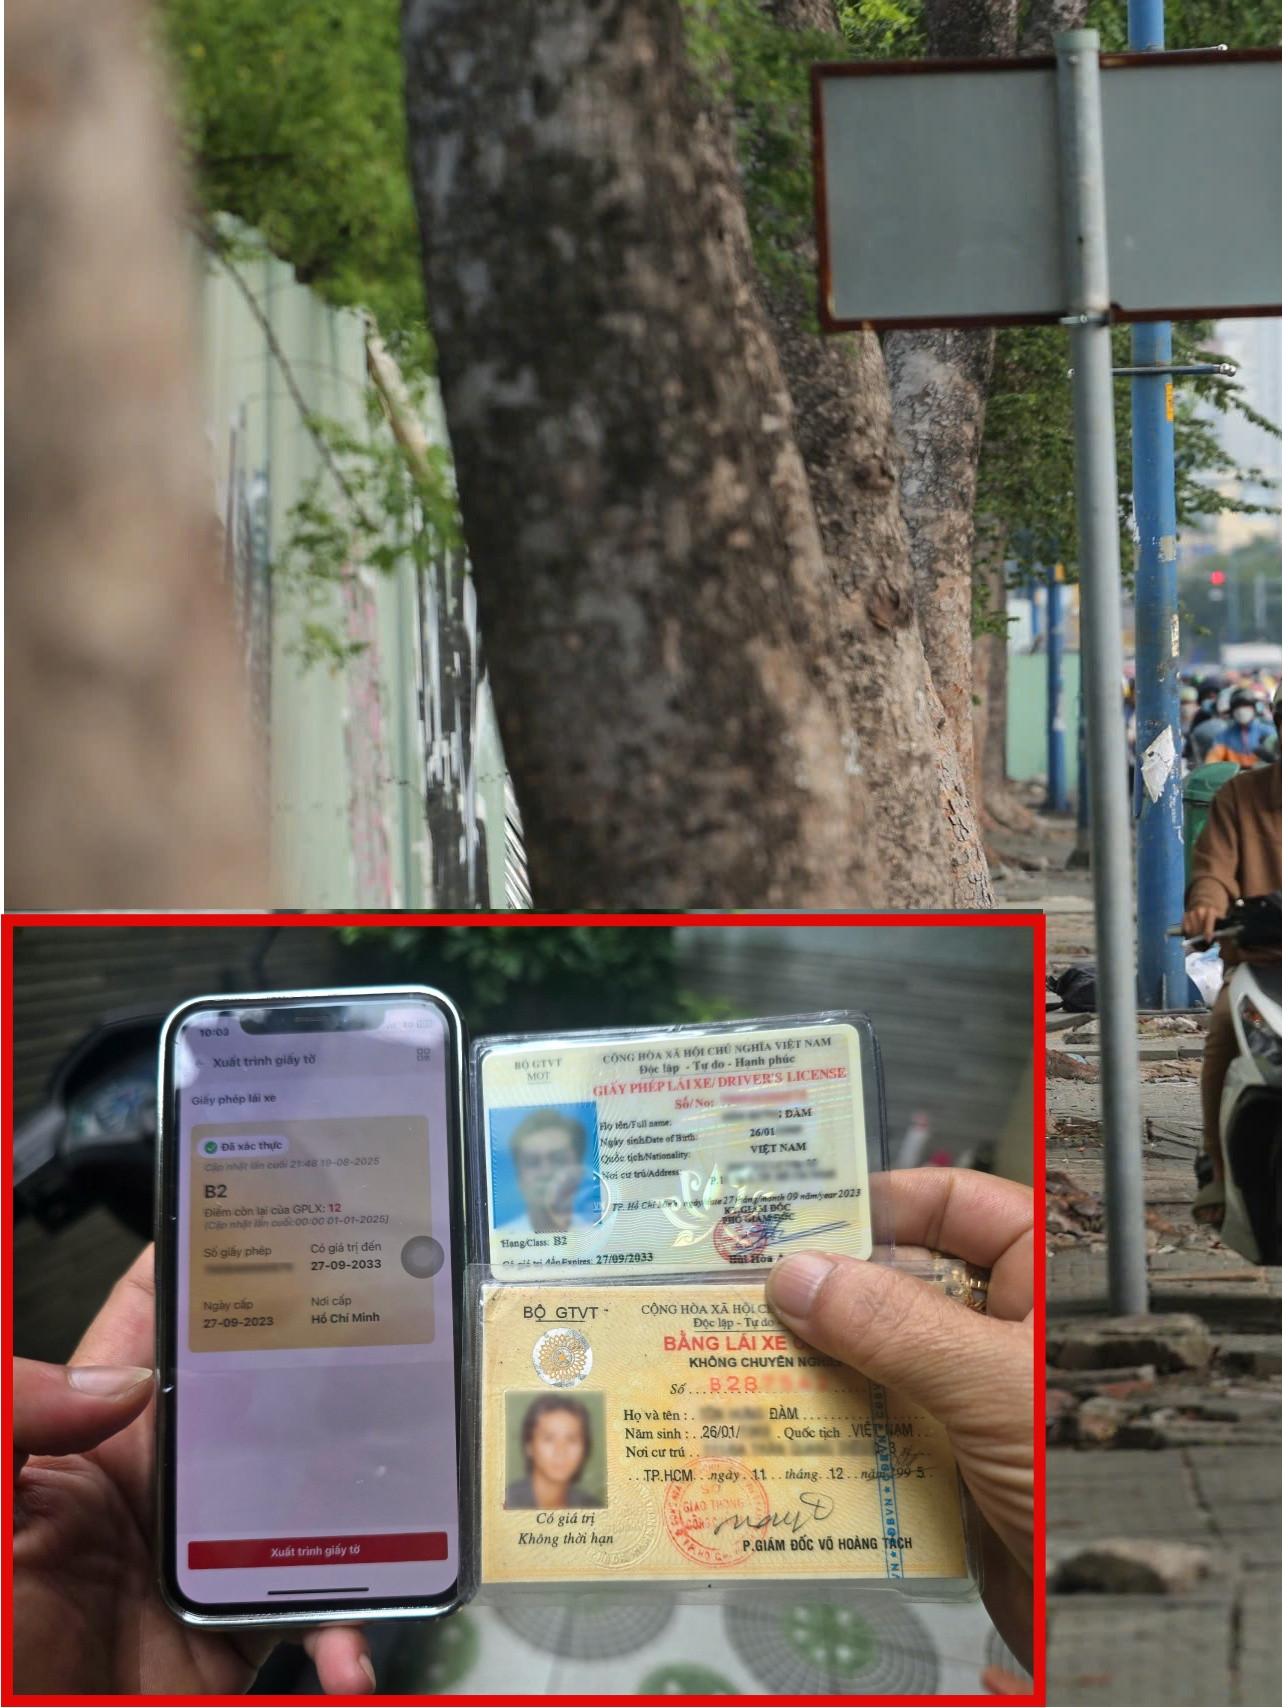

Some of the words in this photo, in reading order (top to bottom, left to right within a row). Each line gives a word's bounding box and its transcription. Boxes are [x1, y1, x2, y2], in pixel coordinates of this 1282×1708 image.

[200, 1028, 230, 1037] 10:03
[603, 1053, 635, 1065] CỘNG
[638, 1050, 663, 1062] HÒA
[684, 1046, 705, 1059] HỘI
[735, 1041, 772, 1054] NGHĨA
[775, 1039, 801, 1052] VIỆT
[804, 1037, 831, 1048] NAM
[213, 1055, 241, 1068] Xuất
[243, 1055, 272, 1067] trình
[275, 1052, 301, 1068] giấy
[303, 1053, 317, 1064] tờ
[532, 1058, 562, 1069] GTVT
[639, 1063, 660, 1076] Độc
[663, 1062, 680, 1075] lập
[692, 1059, 709, 1073] Tự
[712, 1058, 725, 1069] do
[735, 1055, 766, 1069] Hạnh
[768, 1053, 796, 1067] phúc
[527, 1071, 550, 1081] MOT
[593, 1078, 627, 1096] GIẤY
[629, 1077, 664, 1094] PHÉP
[667, 1075, 691, 1091] LÁI
[786, 1067, 847, 1082] LICENSE
[192, 1094, 216, 1107] Giấy
[218, 1094, 246, 1107] phép
[249, 1093, 262, 1103] lái
[264, 1094, 277, 1103] xe
[784, 1107, 812, 1119] ĐÀM
[221, 1142, 235, 1152] Đã
[238, 1141, 256, 1151] xác
[258, 1141, 283, 1152] thực
[600, 1138, 624, 1149] Ngày
[665, 1134, 675, 1143] of
[750, 1143, 777, 1155] VIỆT
[780, 1142, 807, 1153] NAM
[320, 1156, 380, 1168] 19-08-2025
[205, 1184, 228, 1198] B2
[723, 1196, 734, 1205] 27
[786, 1192, 799, 1201] 09
[838, 1188, 862, 1199] 2023
[234, 1204, 254, 1217] còn
[293, 1204, 326, 1215] GPLX:
[328, 1203, 342, 1213] 12
[770, 1202, 791, 1212] ĐỐC
[327, 1214, 389, 1225] 01-01-2025)
[221, 1244, 242, 1259] giấy
[245, 1245, 272, 1259] phép
[311, 1242, 325, 1254] Có
[328, 1242, 344, 1255] giá
[347, 1243, 359, 1255] trị
[361, 1240, 382, 1252] đến
[311, 1259, 382, 1271] 27-09-2033
[596, 1252, 654, 1264] 27/09/2033
[203, 1301, 230, 1313] Ngày
[234, 1297, 254, 1311] cấp
[311, 1296, 329, 1307] Nơi
[332, 1293, 352, 1307] cấp
[523, 1304, 546, 1322] BỘ
[555, 1306, 598, 1319] GTVT
[641, 1302, 678, 1316] CỘNG
[681, 1302, 708, 1314] HÒA
[711, 1302, 729, 1314] XÃ
[732, 1302, 755, 1315] HỘI
[203, 1317, 274, 1329] 27-09-2023
[311, 1311, 327, 1324] Hồ
[330, 1312, 349, 1324] Chí
[352, 1312, 380, 1323] Minh
[693, 1317, 716, 1329] Độc
[719, 1317, 734, 1330] lập
[744, 1317, 759, 1330] Tự
[761, 1318, 774, 1328] do
[664, 1330, 719, 1352] BẰNG
[726, 1332, 755, 1351] LÁI
[761, 1335, 787, 1350] XE
[689, 1354, 737, 1368] KHÔNG
[740, 1354, 794, 1368] CHUYÊN
[670, 1381, 686, 1396] Số
[623, 1409, 642, 1424] Họ
[645, 1410, 660, 1420] và
[663, 1409, 681, 1420] tên
[769, 1406, 799, 1420] ĐÀM
[625, 1426, 651, 1440] Năm
[654, 1426, 682, 1439] sinh
[784, 1425, 816, 1441] Quốc
[819, 1427, 841, 1441] tịch
[886, 1423, 913, 1437] NAM
[626, 1445, 648, 1458] Nơi
[651, 1448, 668, 1458] cư
[669, 1446, 684, 1458] trú
[644, 1468, 693, 1482] TP.HCM
[711, 1469, 739, 1483] ngày
[752, 1468, 766, 1481] 11
[784, 1468, 818, 1483] tháng
[830, 1467, 843, 1480] 12
[536, 1512, 554, 1524] Có
[558, 1512, 578, 1527] giá
[581, 1512, 595, 1526] trị
[518, 1532, 559, 1547] Không
[563, 1532, 587, 1544] thời
[591, 1532, 614, 1547] hạn
[743, 1536, 786, 1552] P.GIÁM
[790, 1534, 814, 1551] ĐỐC
[818, 1536, 834, 1550] VÕ
[838, 1534, 878, 1550] HOÀNG
[271, 1545, 295, 1557] Xuất
[297, 1545, 323, 1557] trình
[325, 1543, 347, 1557] giấy
[349, 1544, 360, 1554] tờ
